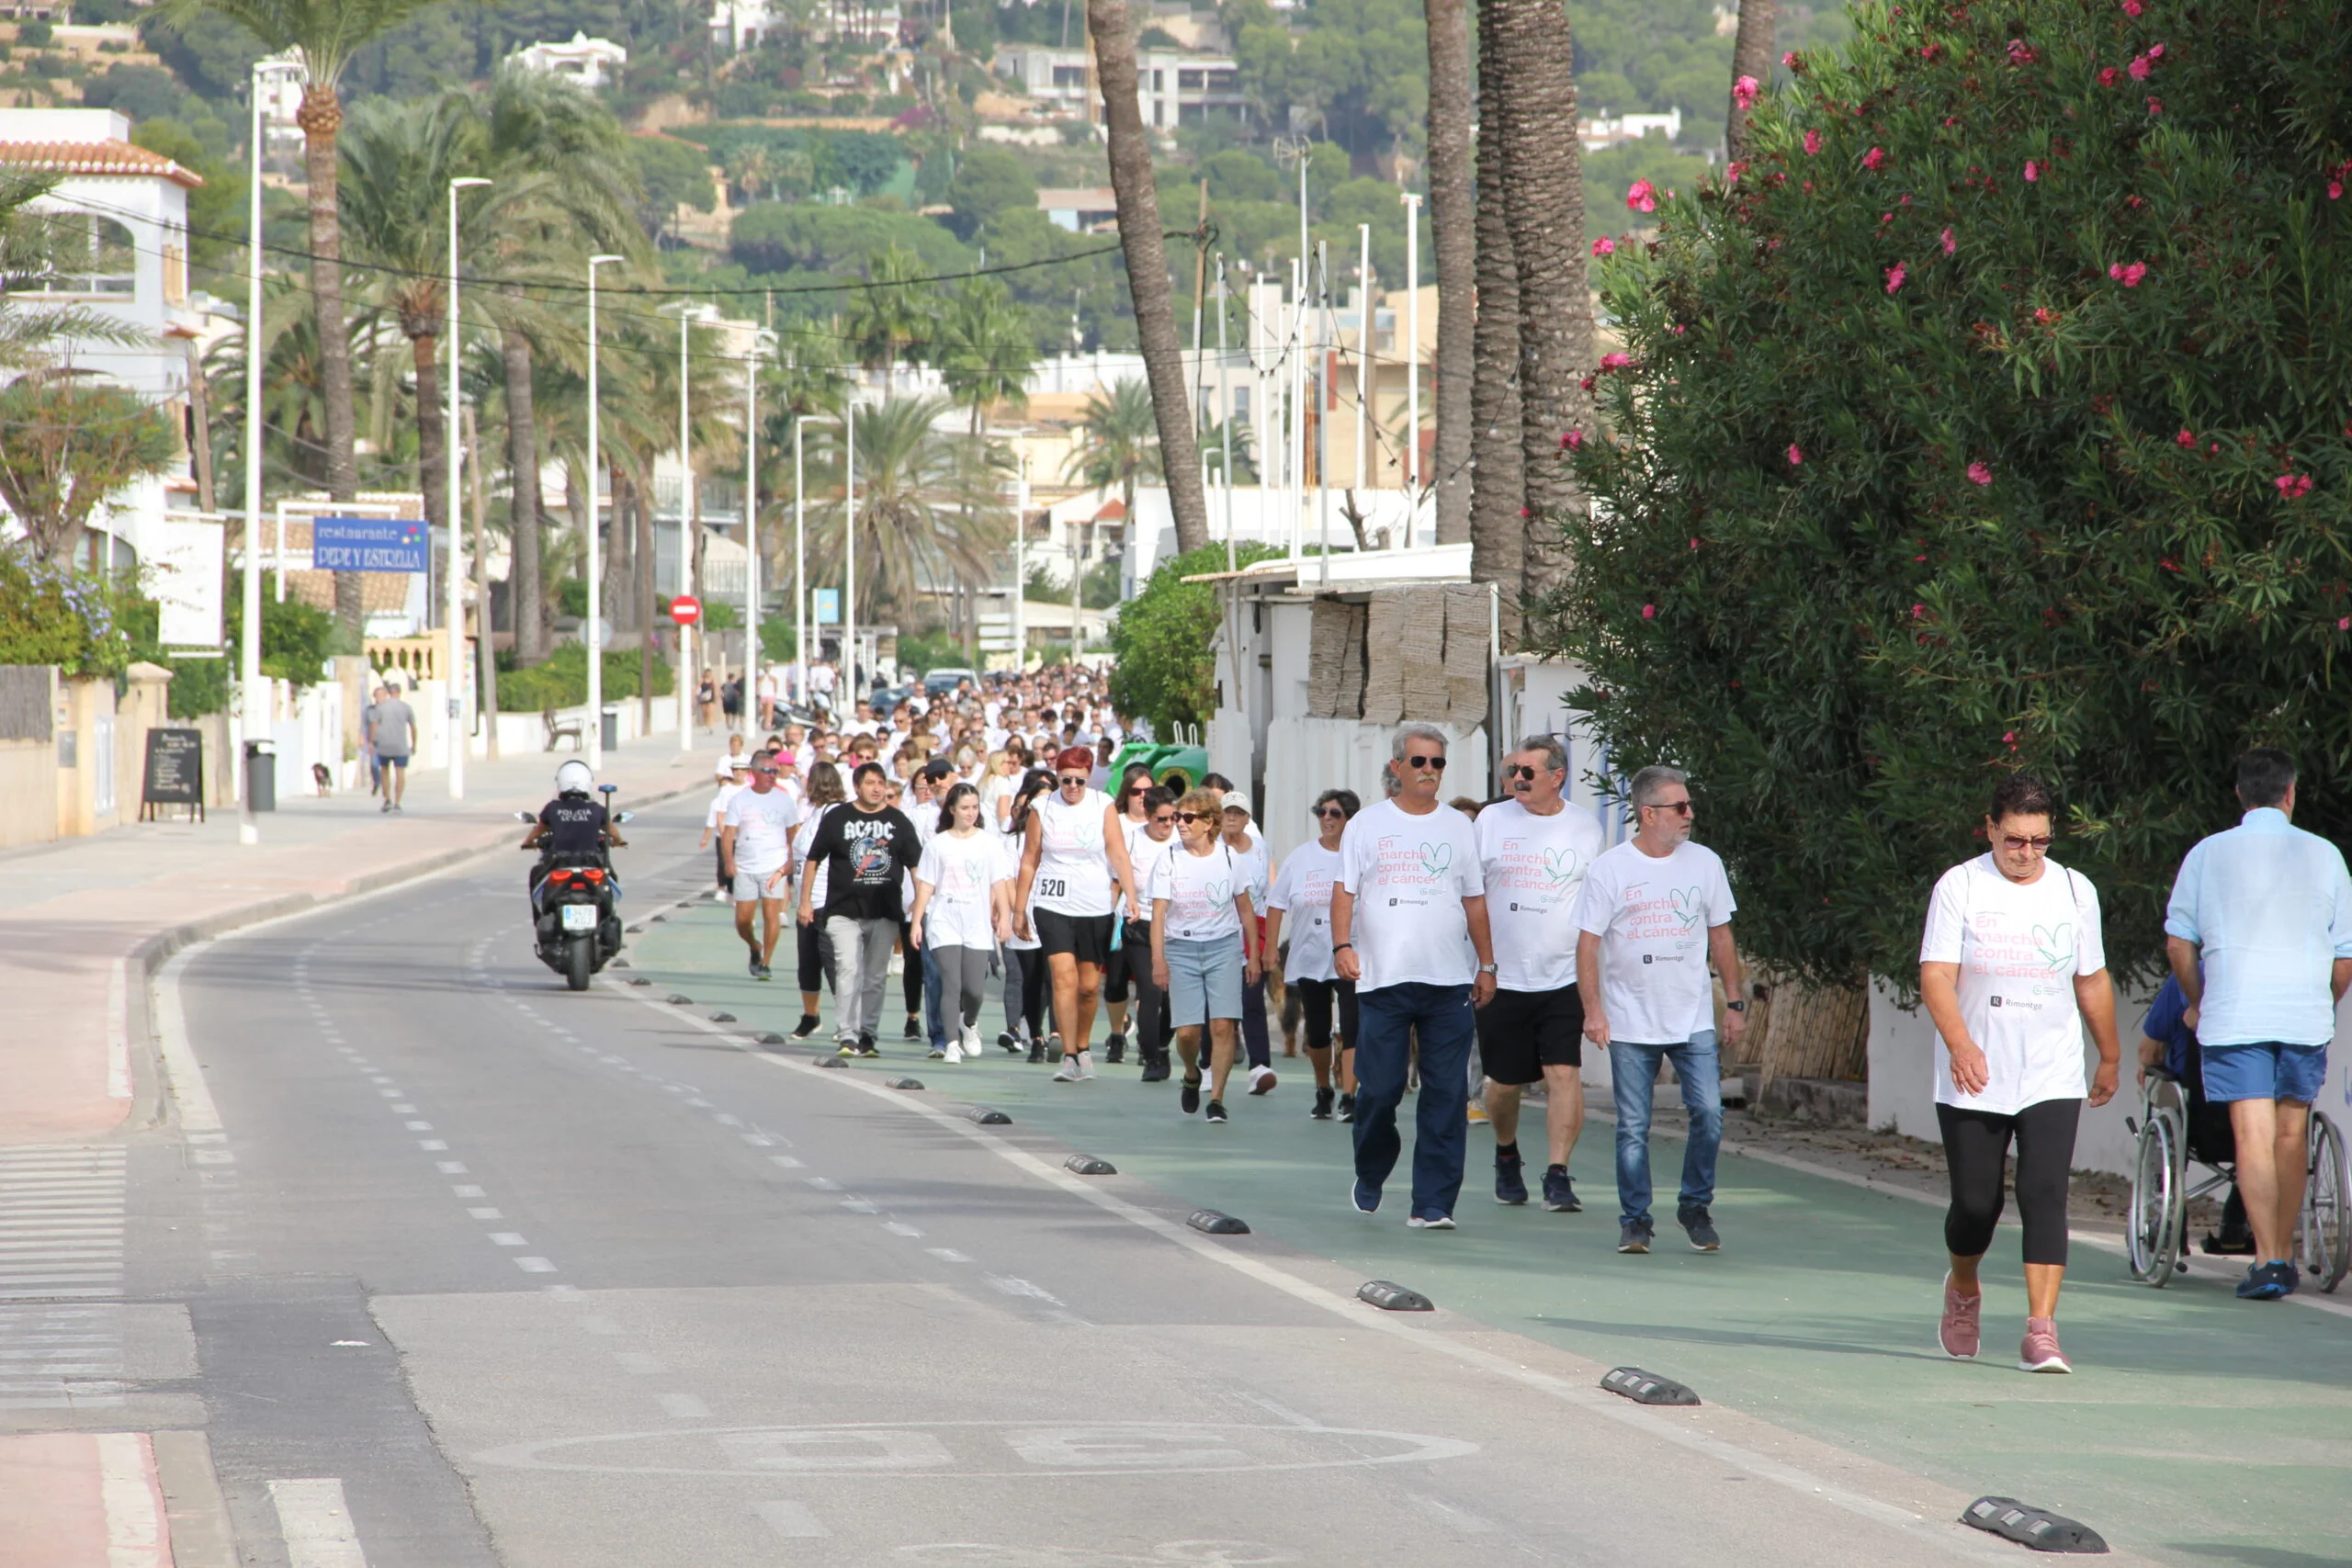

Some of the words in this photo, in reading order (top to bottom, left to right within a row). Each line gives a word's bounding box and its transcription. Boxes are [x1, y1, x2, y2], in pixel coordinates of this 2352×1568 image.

[318, 526, 399, 540] restaurante
[364, 548, 420, 568] ESTRELLA
[1378, 840, 1393, 851] En
[1503, 840, 1518, 851] En
[1377, 850, 1427, 861] marcha
[1501, 853, 1551, 865] marcha
[1377, 863, 1420, 874] contra
[1499, 866, 1542, 877] contra
[1041, 879, 1066, 897] 520
[1625, 889, 1642, 900] En
[1627, 898, 1679, 912] marcha
[1630, 913, 1672, 926] contra
[1975, 916, 1996, 929] En
[1975, 931, 2043, 946] marcha
[1973, 947, 2033, 962] contra
[1973, 961, 1988, 975] el
